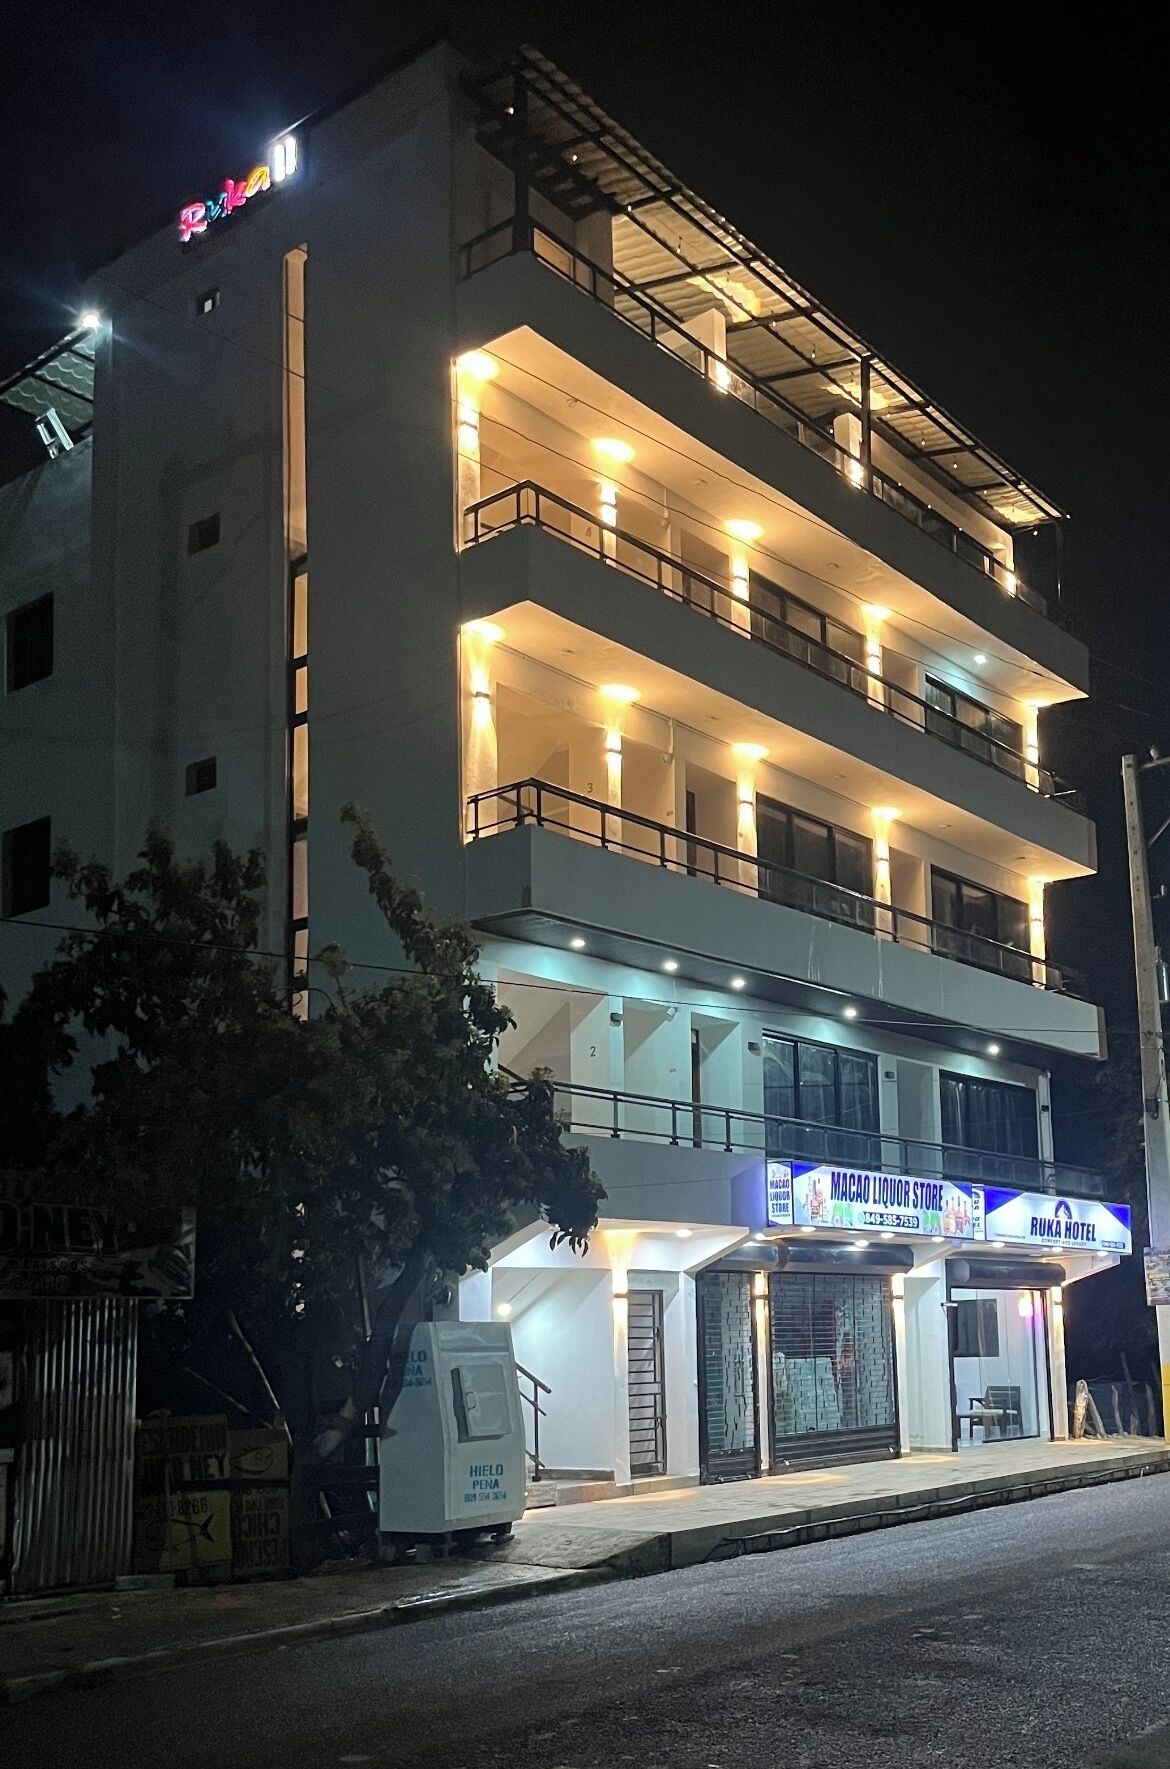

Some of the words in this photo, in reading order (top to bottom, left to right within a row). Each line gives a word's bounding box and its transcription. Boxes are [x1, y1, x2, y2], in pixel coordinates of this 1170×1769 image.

[179, 165, 271, 242] Ruka
[587, 782, 593, 793] 3
[590, 1046, 596, 1057] 2
[769, 1178, 790, 1190] MACAO
[769, 1190, 790, 1202] LIQUOR
[830, 1171, 871, 1203] MACAO
[872, 1176, 909, 1209] LIQUOR
[913, 1180, 943, 1212] STORE
[771, 1202, 790, 1214] STORE
[865, 1211, 919, 1228] 849-585-7539
[1030, 1216, 1062, 1239] RUKA
[1064, 1220, 1096, 1242] HOTEL
[469, 1463, 504, 1477] HIELO
